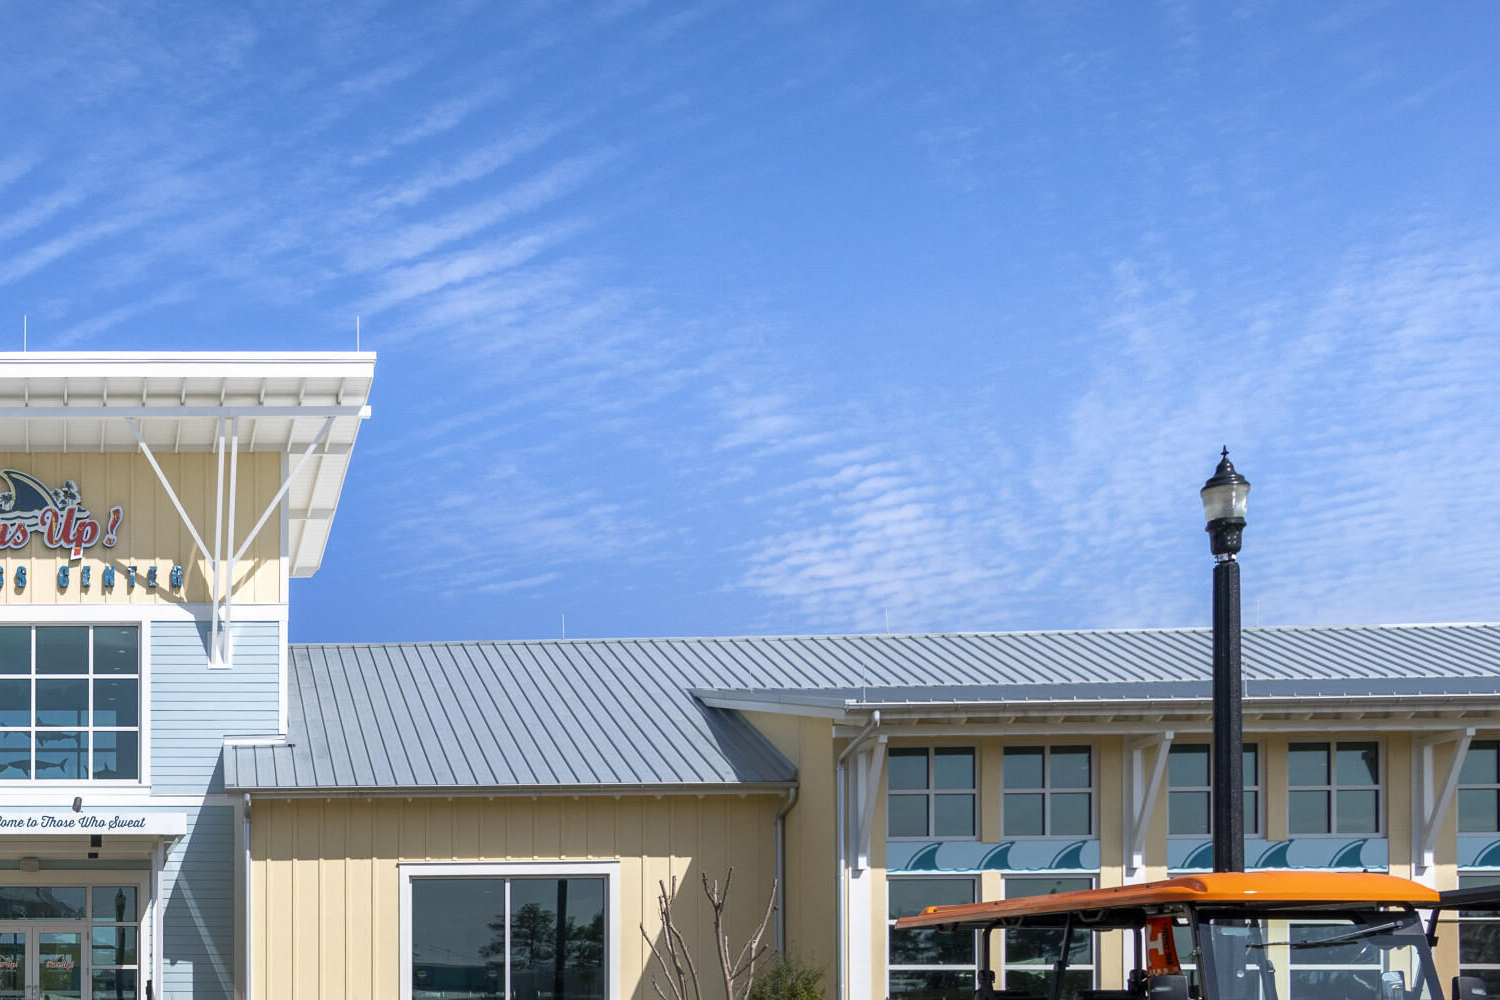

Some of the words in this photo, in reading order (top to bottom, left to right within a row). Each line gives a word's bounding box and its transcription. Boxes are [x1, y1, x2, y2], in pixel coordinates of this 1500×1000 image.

[57, 565, 183, 588] CENTER
[26, 817, 39, 828] to
[41, 815, 76, 829] Those
[78, 815, 106, 829] Who
[108, 815, 146, 831] Sweat
